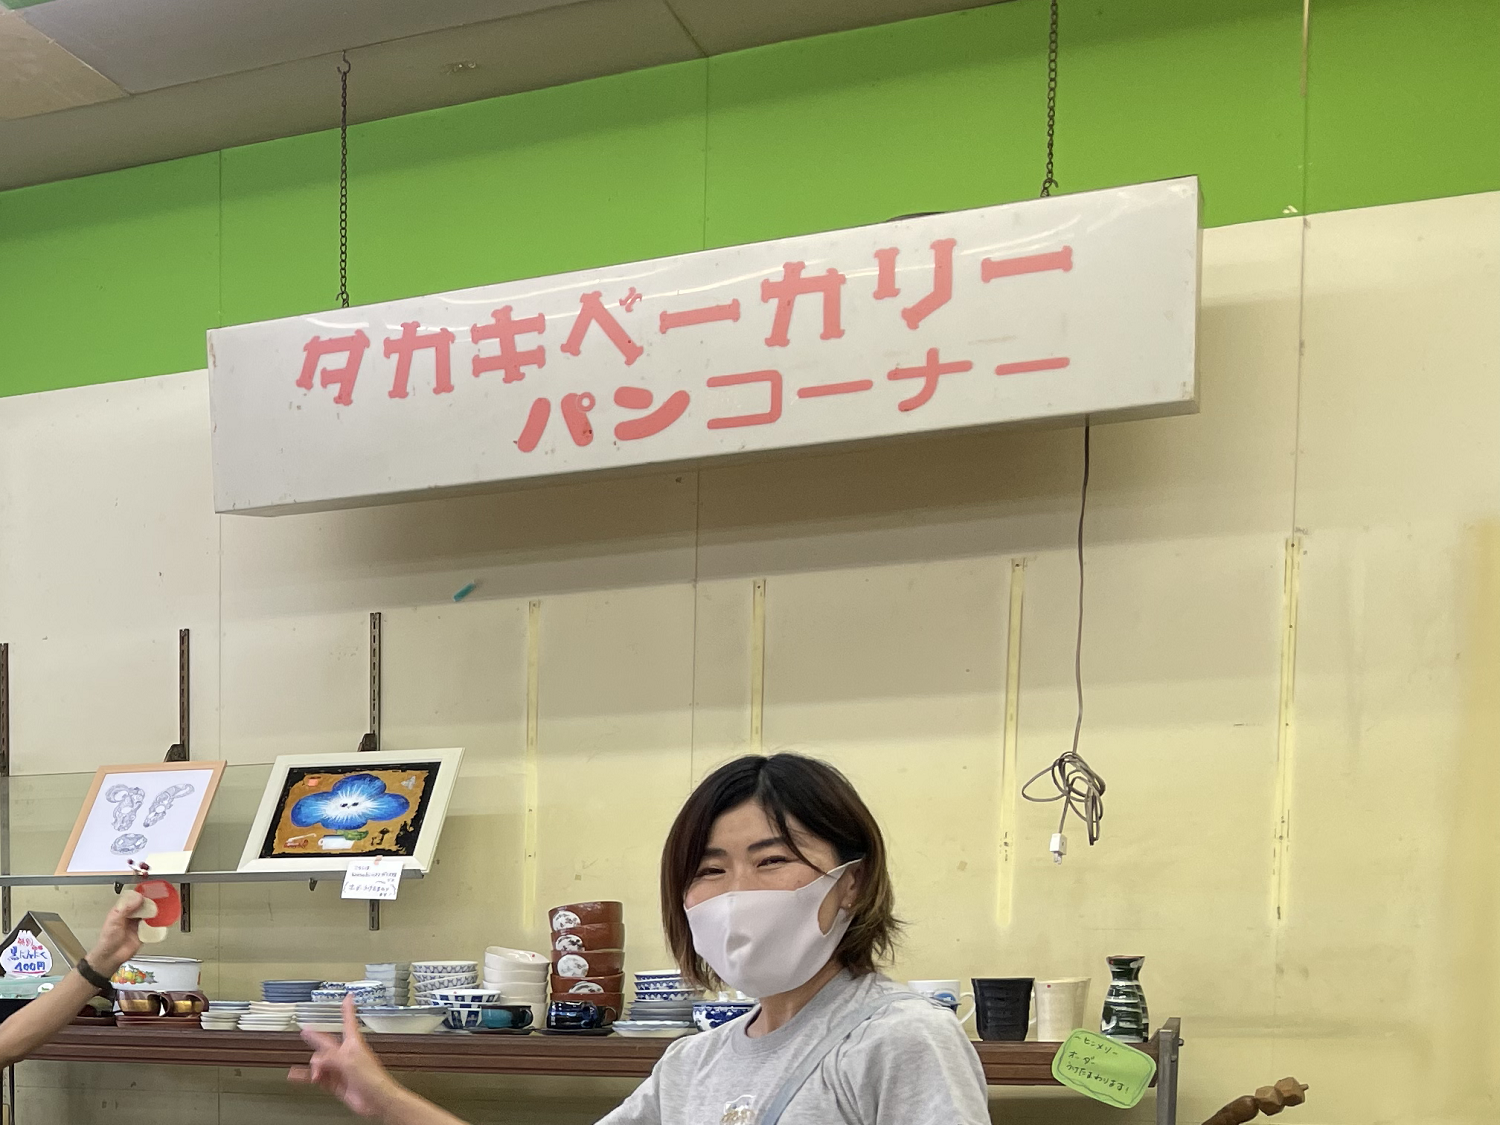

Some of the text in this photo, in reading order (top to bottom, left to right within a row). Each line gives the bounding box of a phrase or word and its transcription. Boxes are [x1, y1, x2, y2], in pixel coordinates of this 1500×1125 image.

[297, 238, 1073, 405] タカキベーカリー
[513, 349, 1070, 454] パンコーナー
[14, 961, 46, 972] 100円
